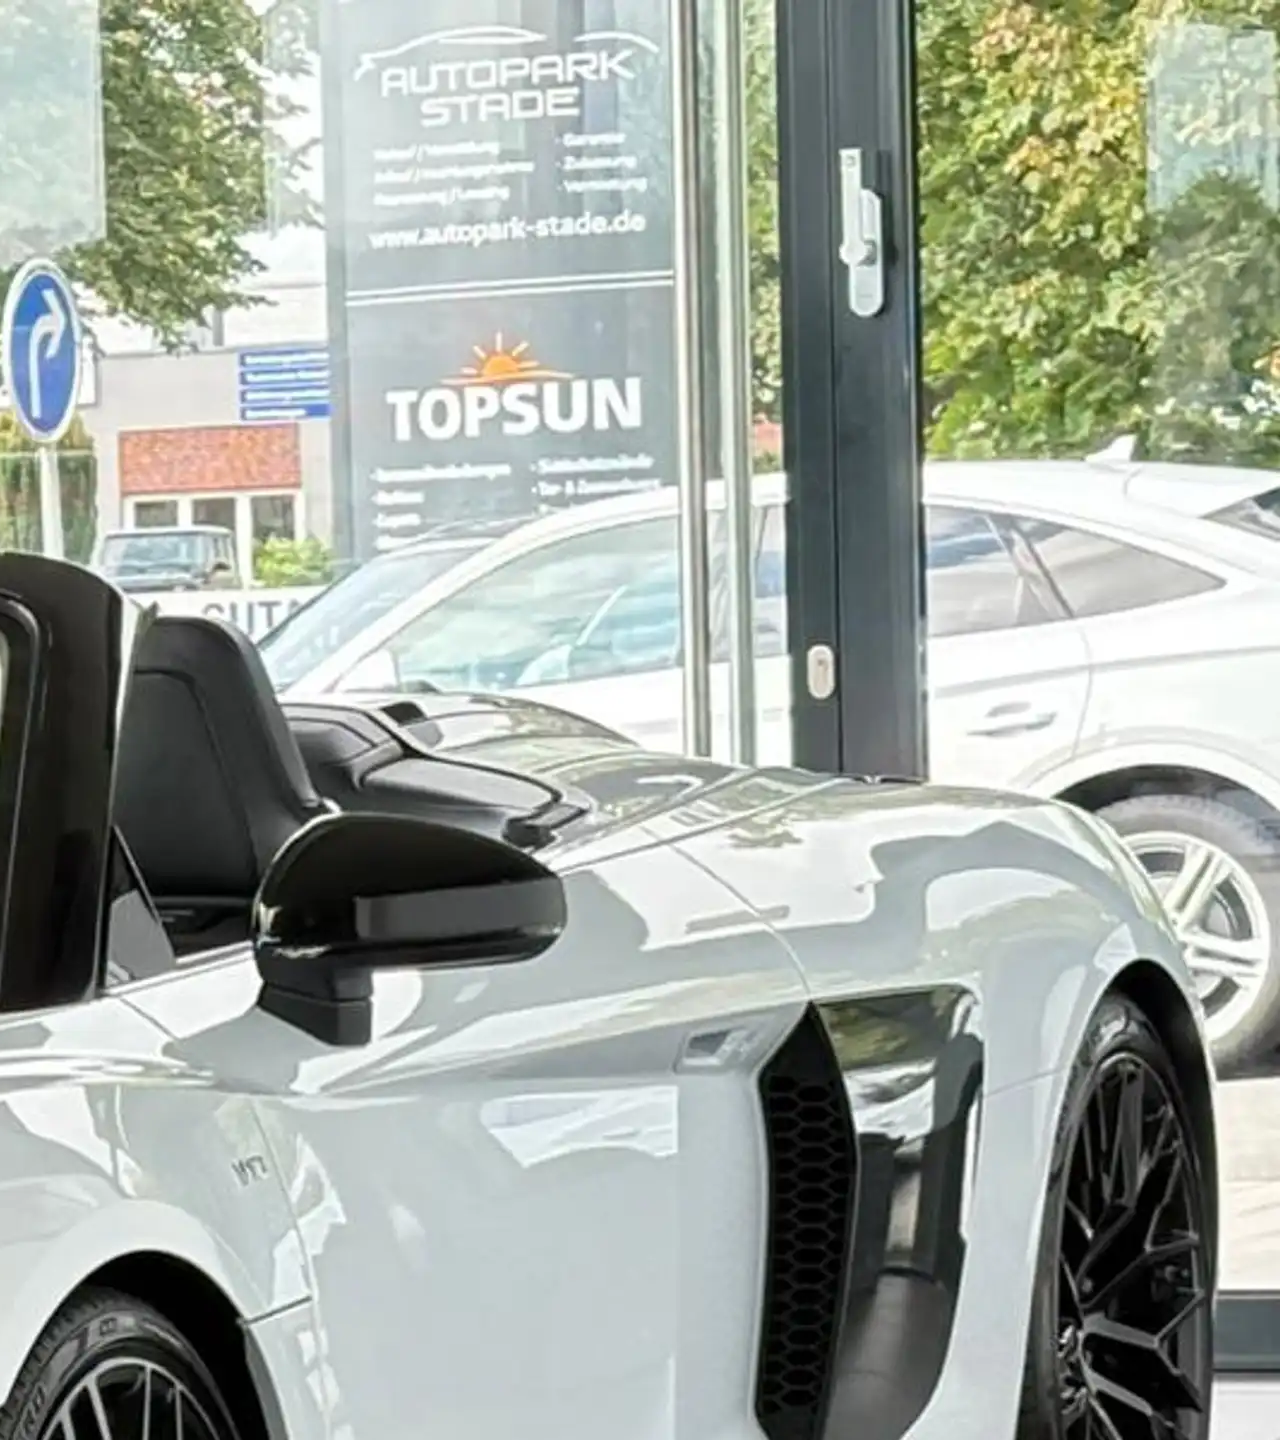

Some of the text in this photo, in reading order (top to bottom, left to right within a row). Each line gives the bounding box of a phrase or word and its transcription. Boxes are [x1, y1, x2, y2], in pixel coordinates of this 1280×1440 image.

[380, 50, 636, 98] AUTOPARK
[420, 86, 581, 128] STADE
[368, 210, 647, 249] www.autopark-stade.de
[385, 377, 642, 442] TOPSUN
